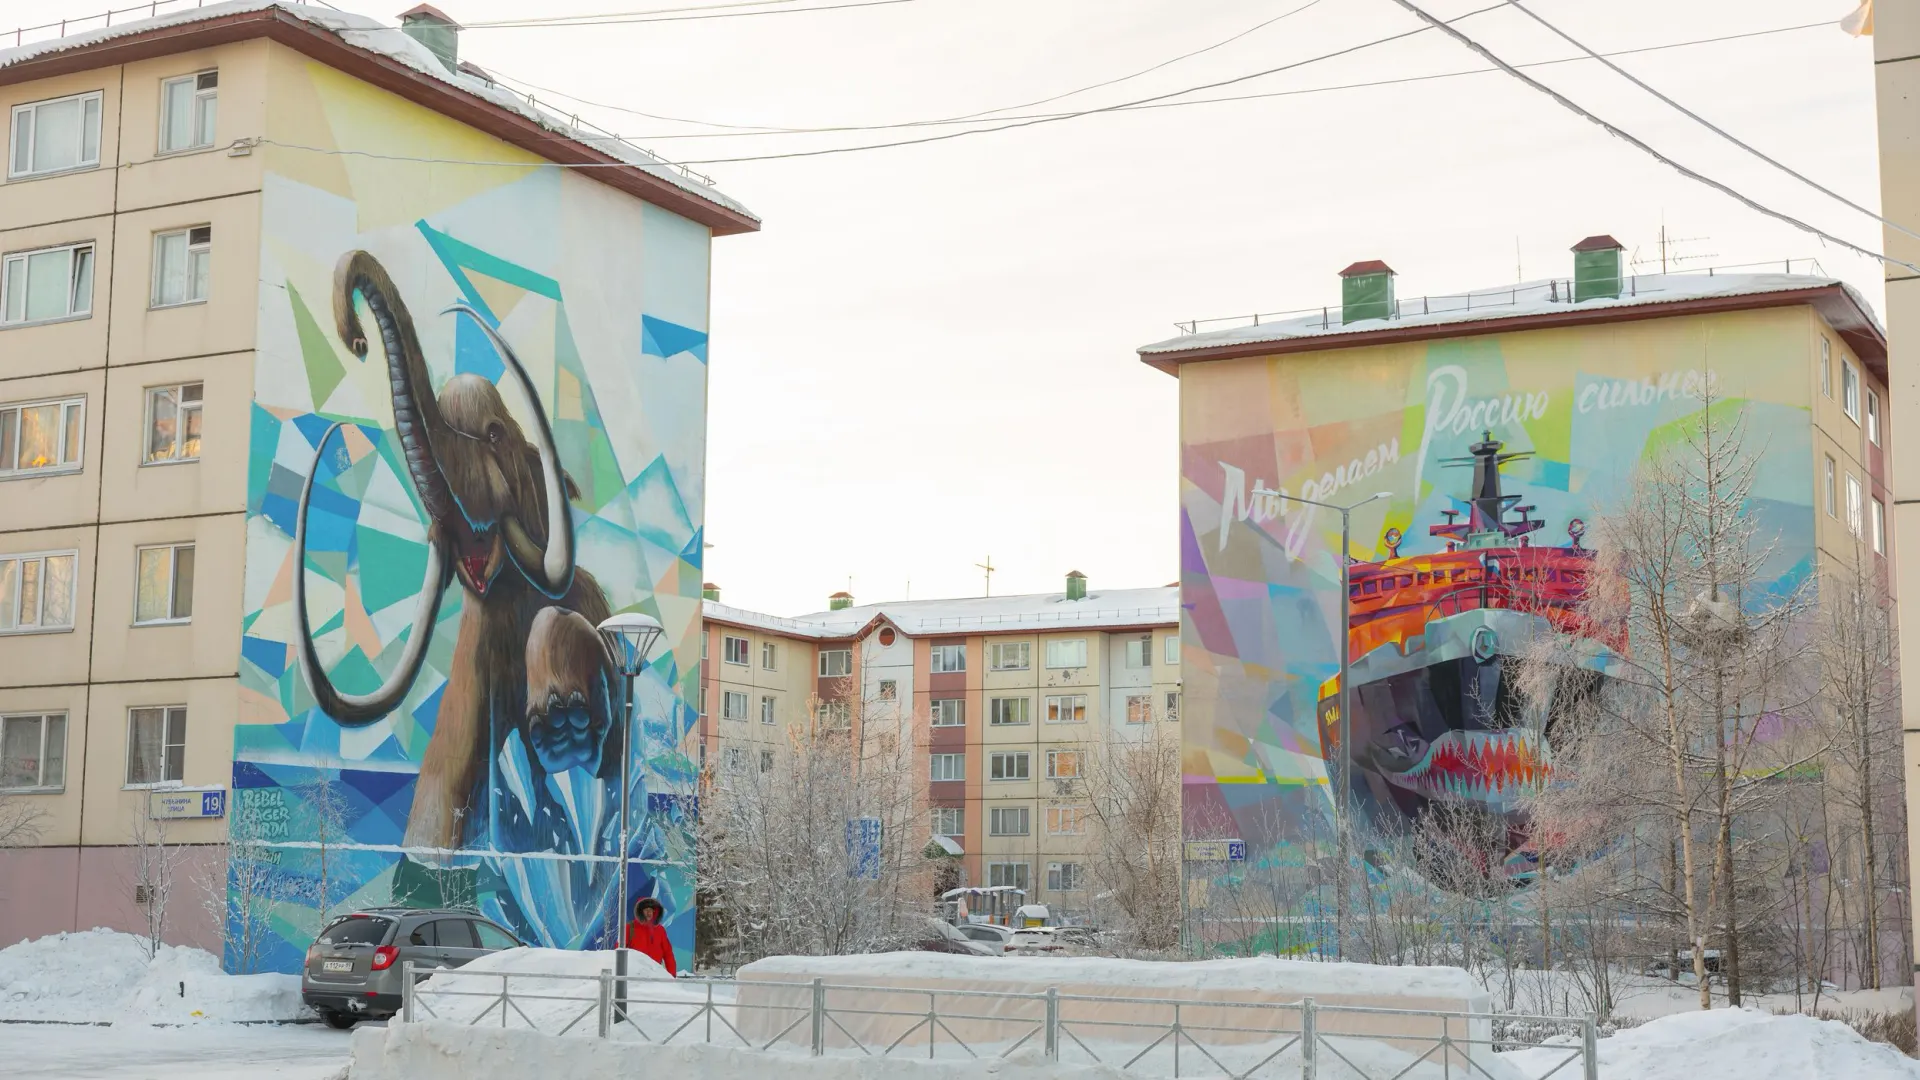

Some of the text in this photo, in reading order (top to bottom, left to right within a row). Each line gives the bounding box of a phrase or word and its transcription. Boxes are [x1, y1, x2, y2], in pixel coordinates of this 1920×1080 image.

[1285, 437, 1400, 562] делаем
[1414, 364, 1549, 507] Россию
[204, 796, 219, 812] 19
[242, 789, 285, 808] REBEL
[1231, 845, 1244, 858] 21
